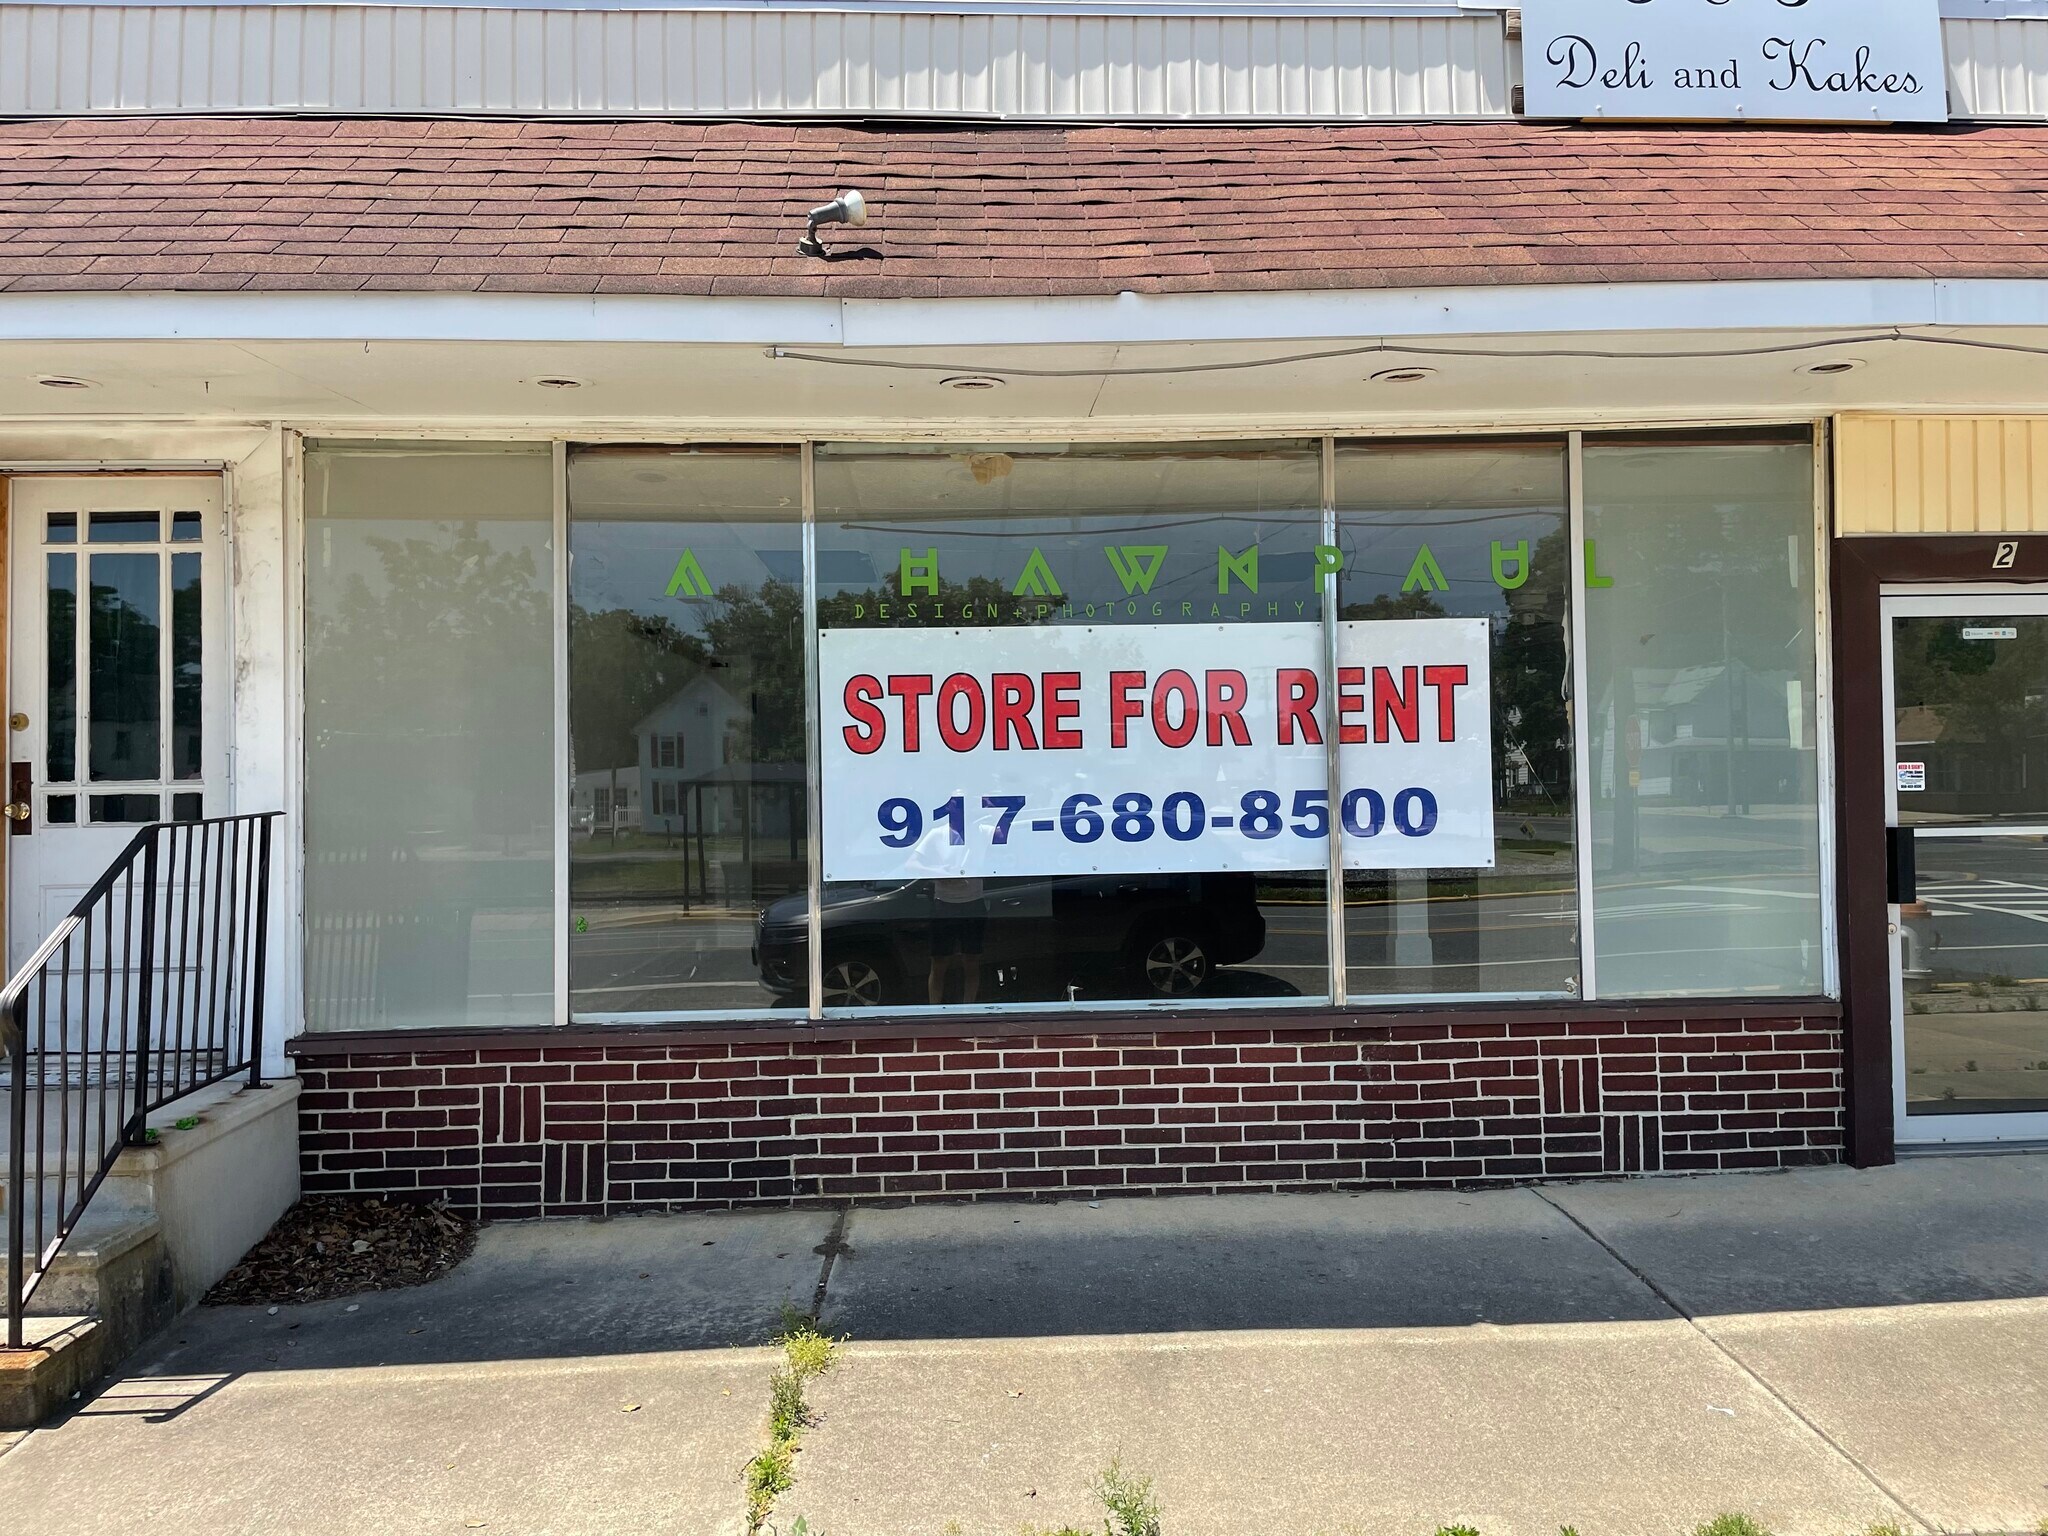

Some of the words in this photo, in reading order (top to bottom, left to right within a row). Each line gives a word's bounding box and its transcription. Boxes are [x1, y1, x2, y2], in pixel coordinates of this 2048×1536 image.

[1546, 35, 1653, 89] Deli
[1673, 59, 1742, 90] and
[1762, 37, 1924, 95] Kakes
[1997, 544, 2013, 566] 2
[842, 672, 1083, 755] STORE
[1109, 669, 1253, 749] FOR
[1276, 664, 1469, 746] RENT
[877, 787, 1438, 848] 917-680-8500
